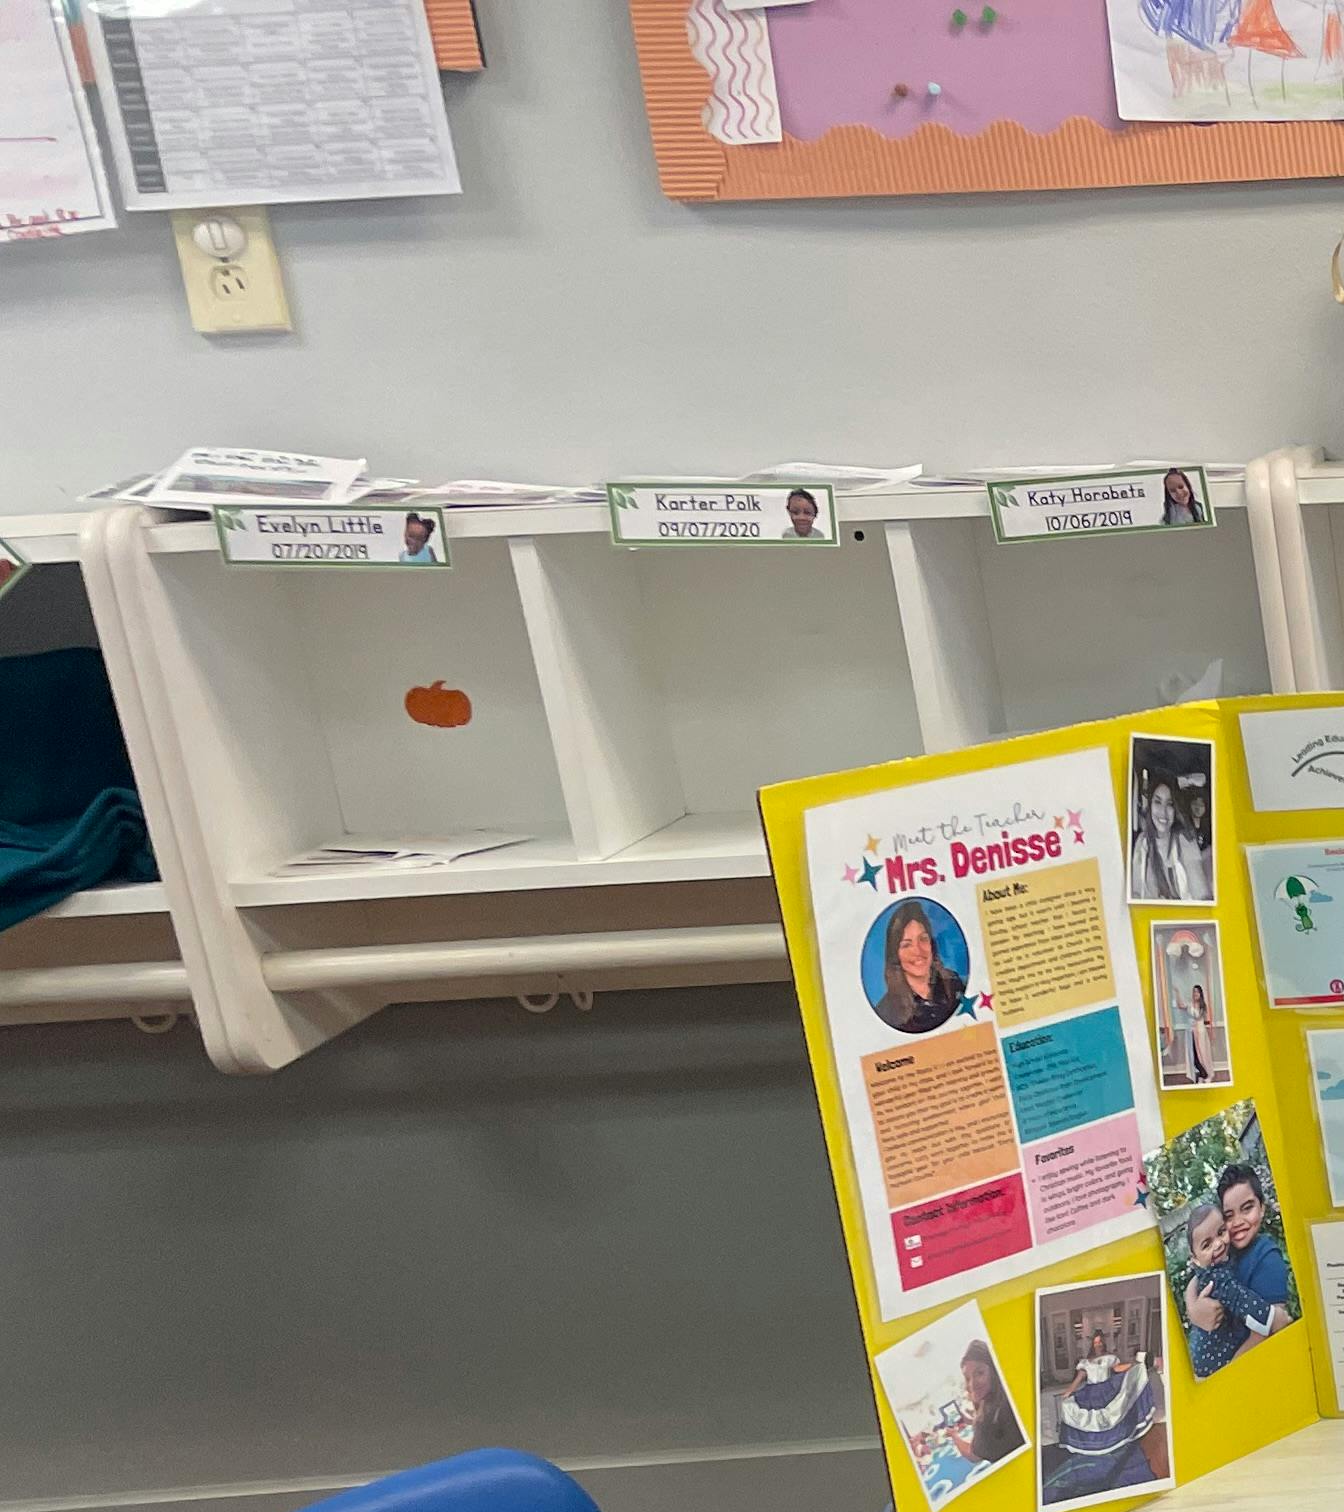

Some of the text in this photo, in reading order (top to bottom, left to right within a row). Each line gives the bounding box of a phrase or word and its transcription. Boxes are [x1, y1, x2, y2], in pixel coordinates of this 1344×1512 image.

[655, 493, 762, 512] Karter Polk
[1027, 484, 1146, 508] Katy Horobets
[256, 514, 384, 538] Evelyn Little
[658, 522, 761, 538] 09/07/2020
[1045, 510, 1133, 532] 10/06/2019
[1291, 738, 1325, 764] Leading
[885, 830, 1062, 894] Mrs. Denisse
